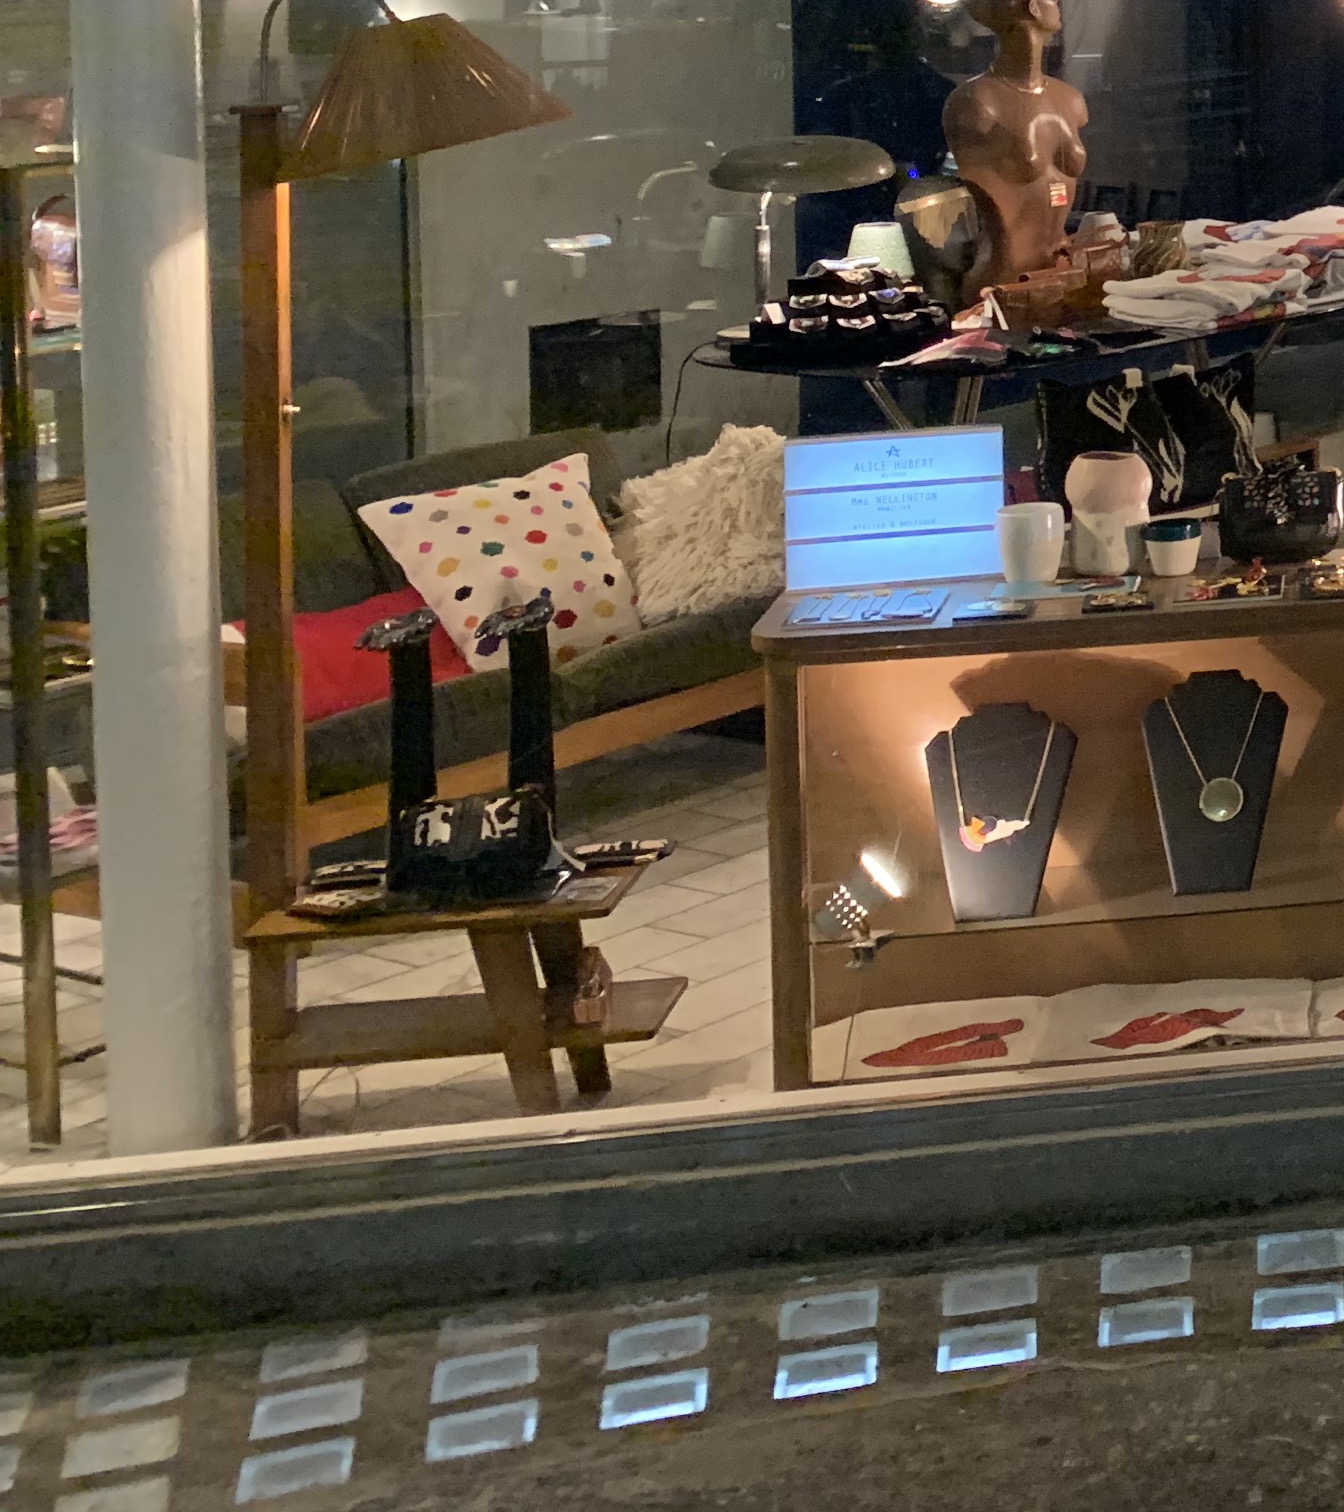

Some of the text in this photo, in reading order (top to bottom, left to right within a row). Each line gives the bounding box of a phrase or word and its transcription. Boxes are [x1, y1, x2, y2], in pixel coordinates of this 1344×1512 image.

[854, 458, 934, 472] ALICE HUBERT
[875, 492, 937, 504] WELLINGTON
